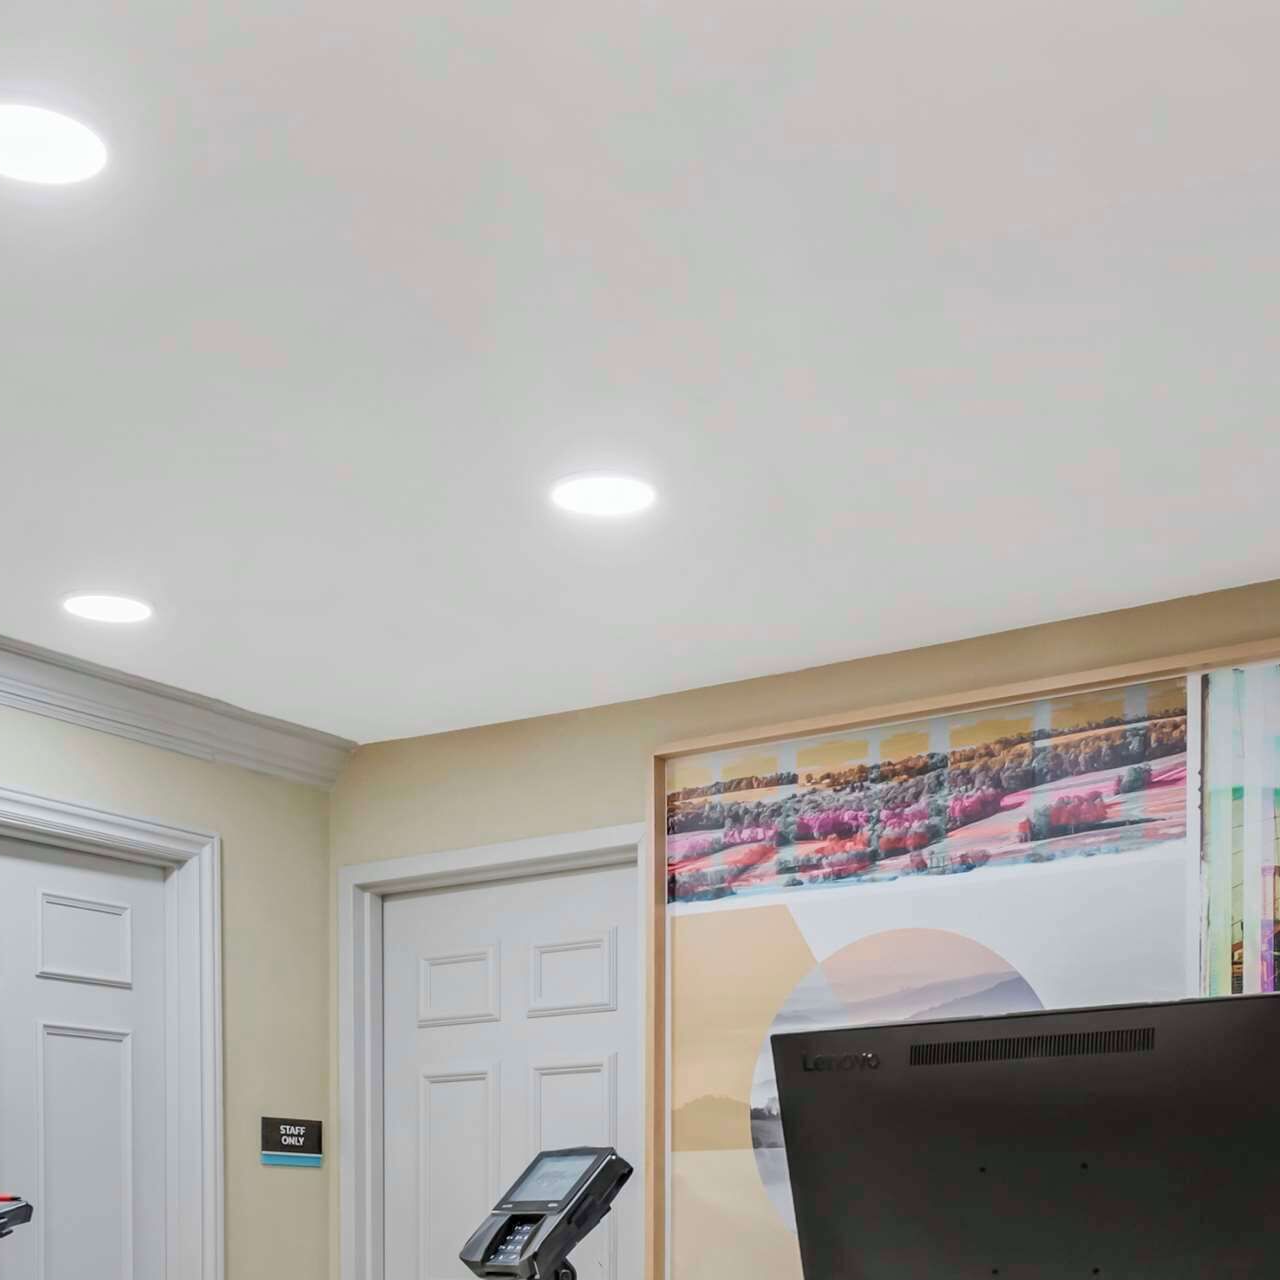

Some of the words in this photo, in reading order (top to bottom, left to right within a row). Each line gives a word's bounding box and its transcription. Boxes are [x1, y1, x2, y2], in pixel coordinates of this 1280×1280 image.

[802, 1053, 880, 1072] Lenovo
[280, 1125, 306, 1135] STAFF
[281, 1136, 305, 1146] ONLY
